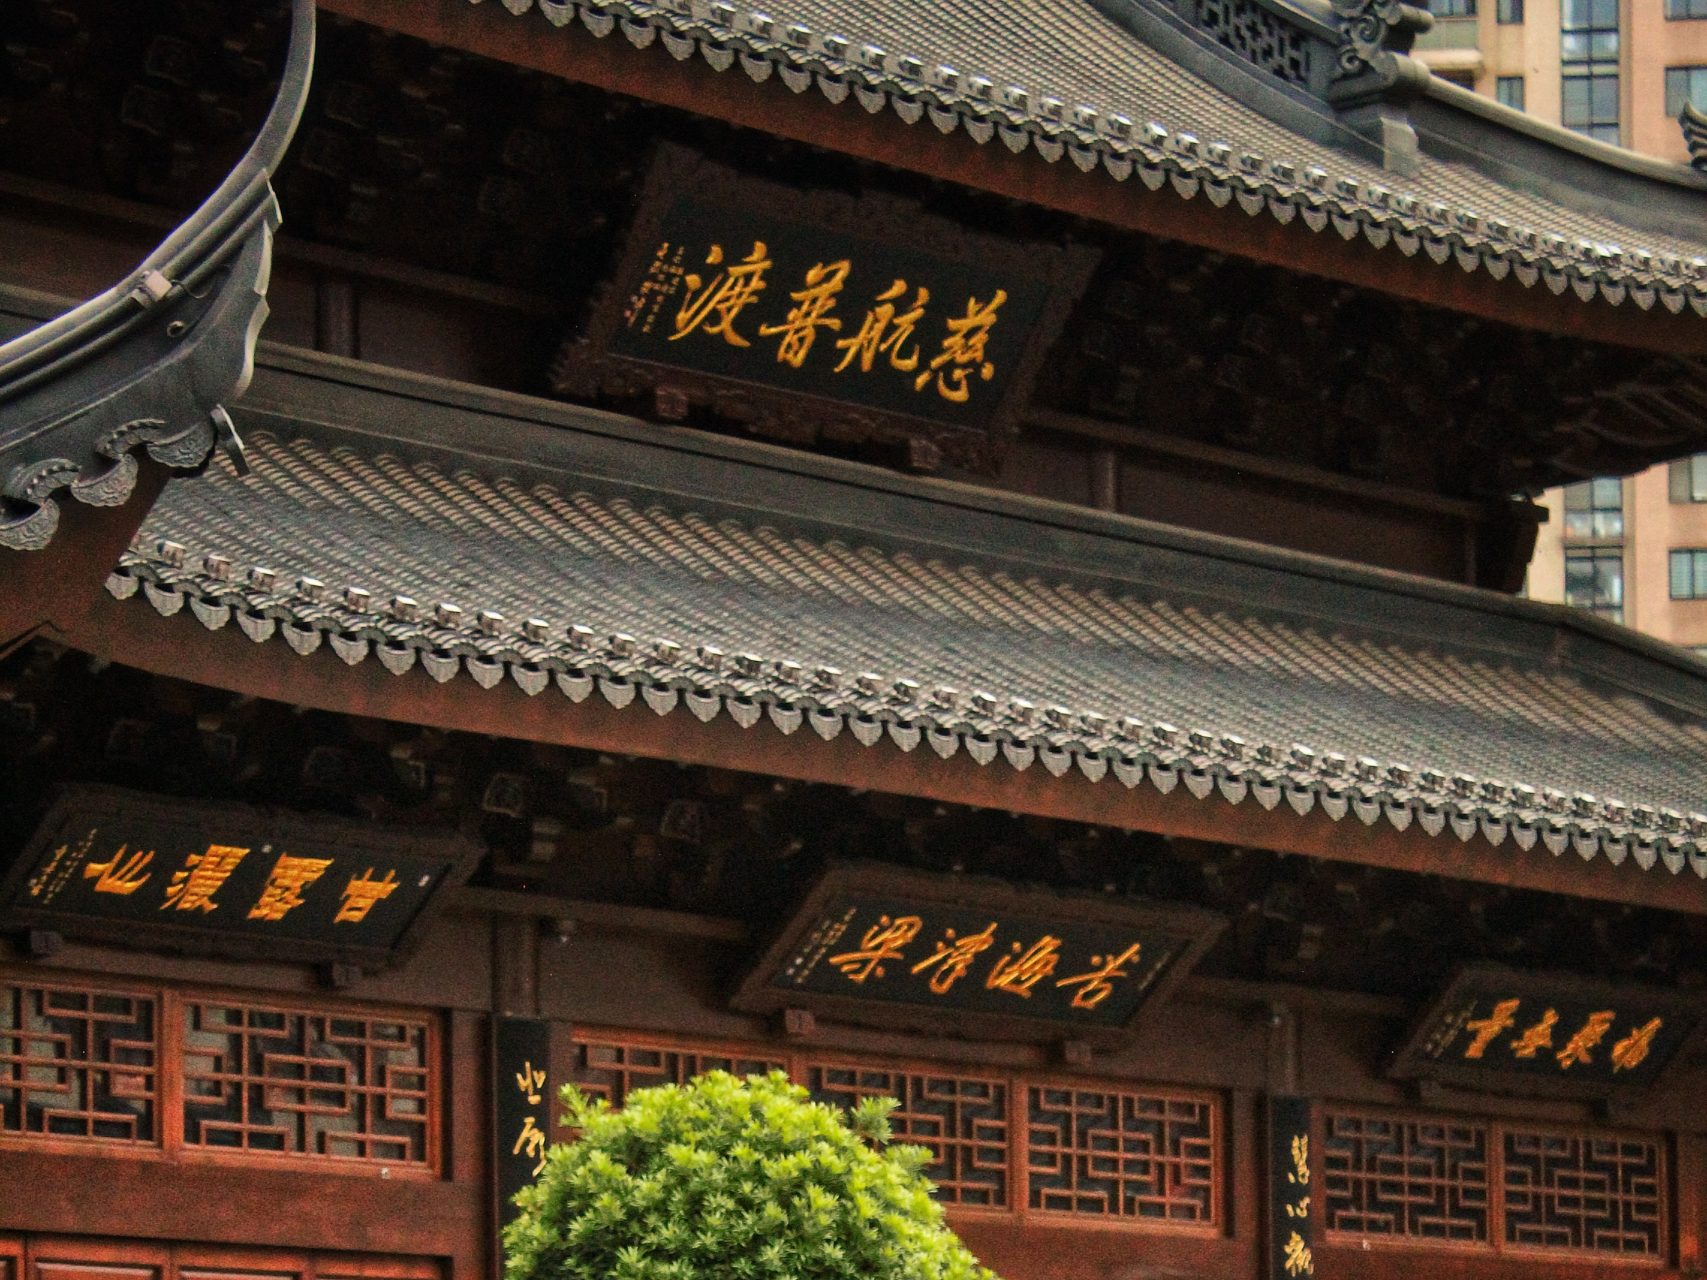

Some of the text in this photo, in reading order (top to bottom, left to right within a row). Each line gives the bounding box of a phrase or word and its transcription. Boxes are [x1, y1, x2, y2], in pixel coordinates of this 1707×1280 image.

[667, 240, 1009, 404] 慈航普渡
[828, 909, 1141, 1010] 苦海津梁
